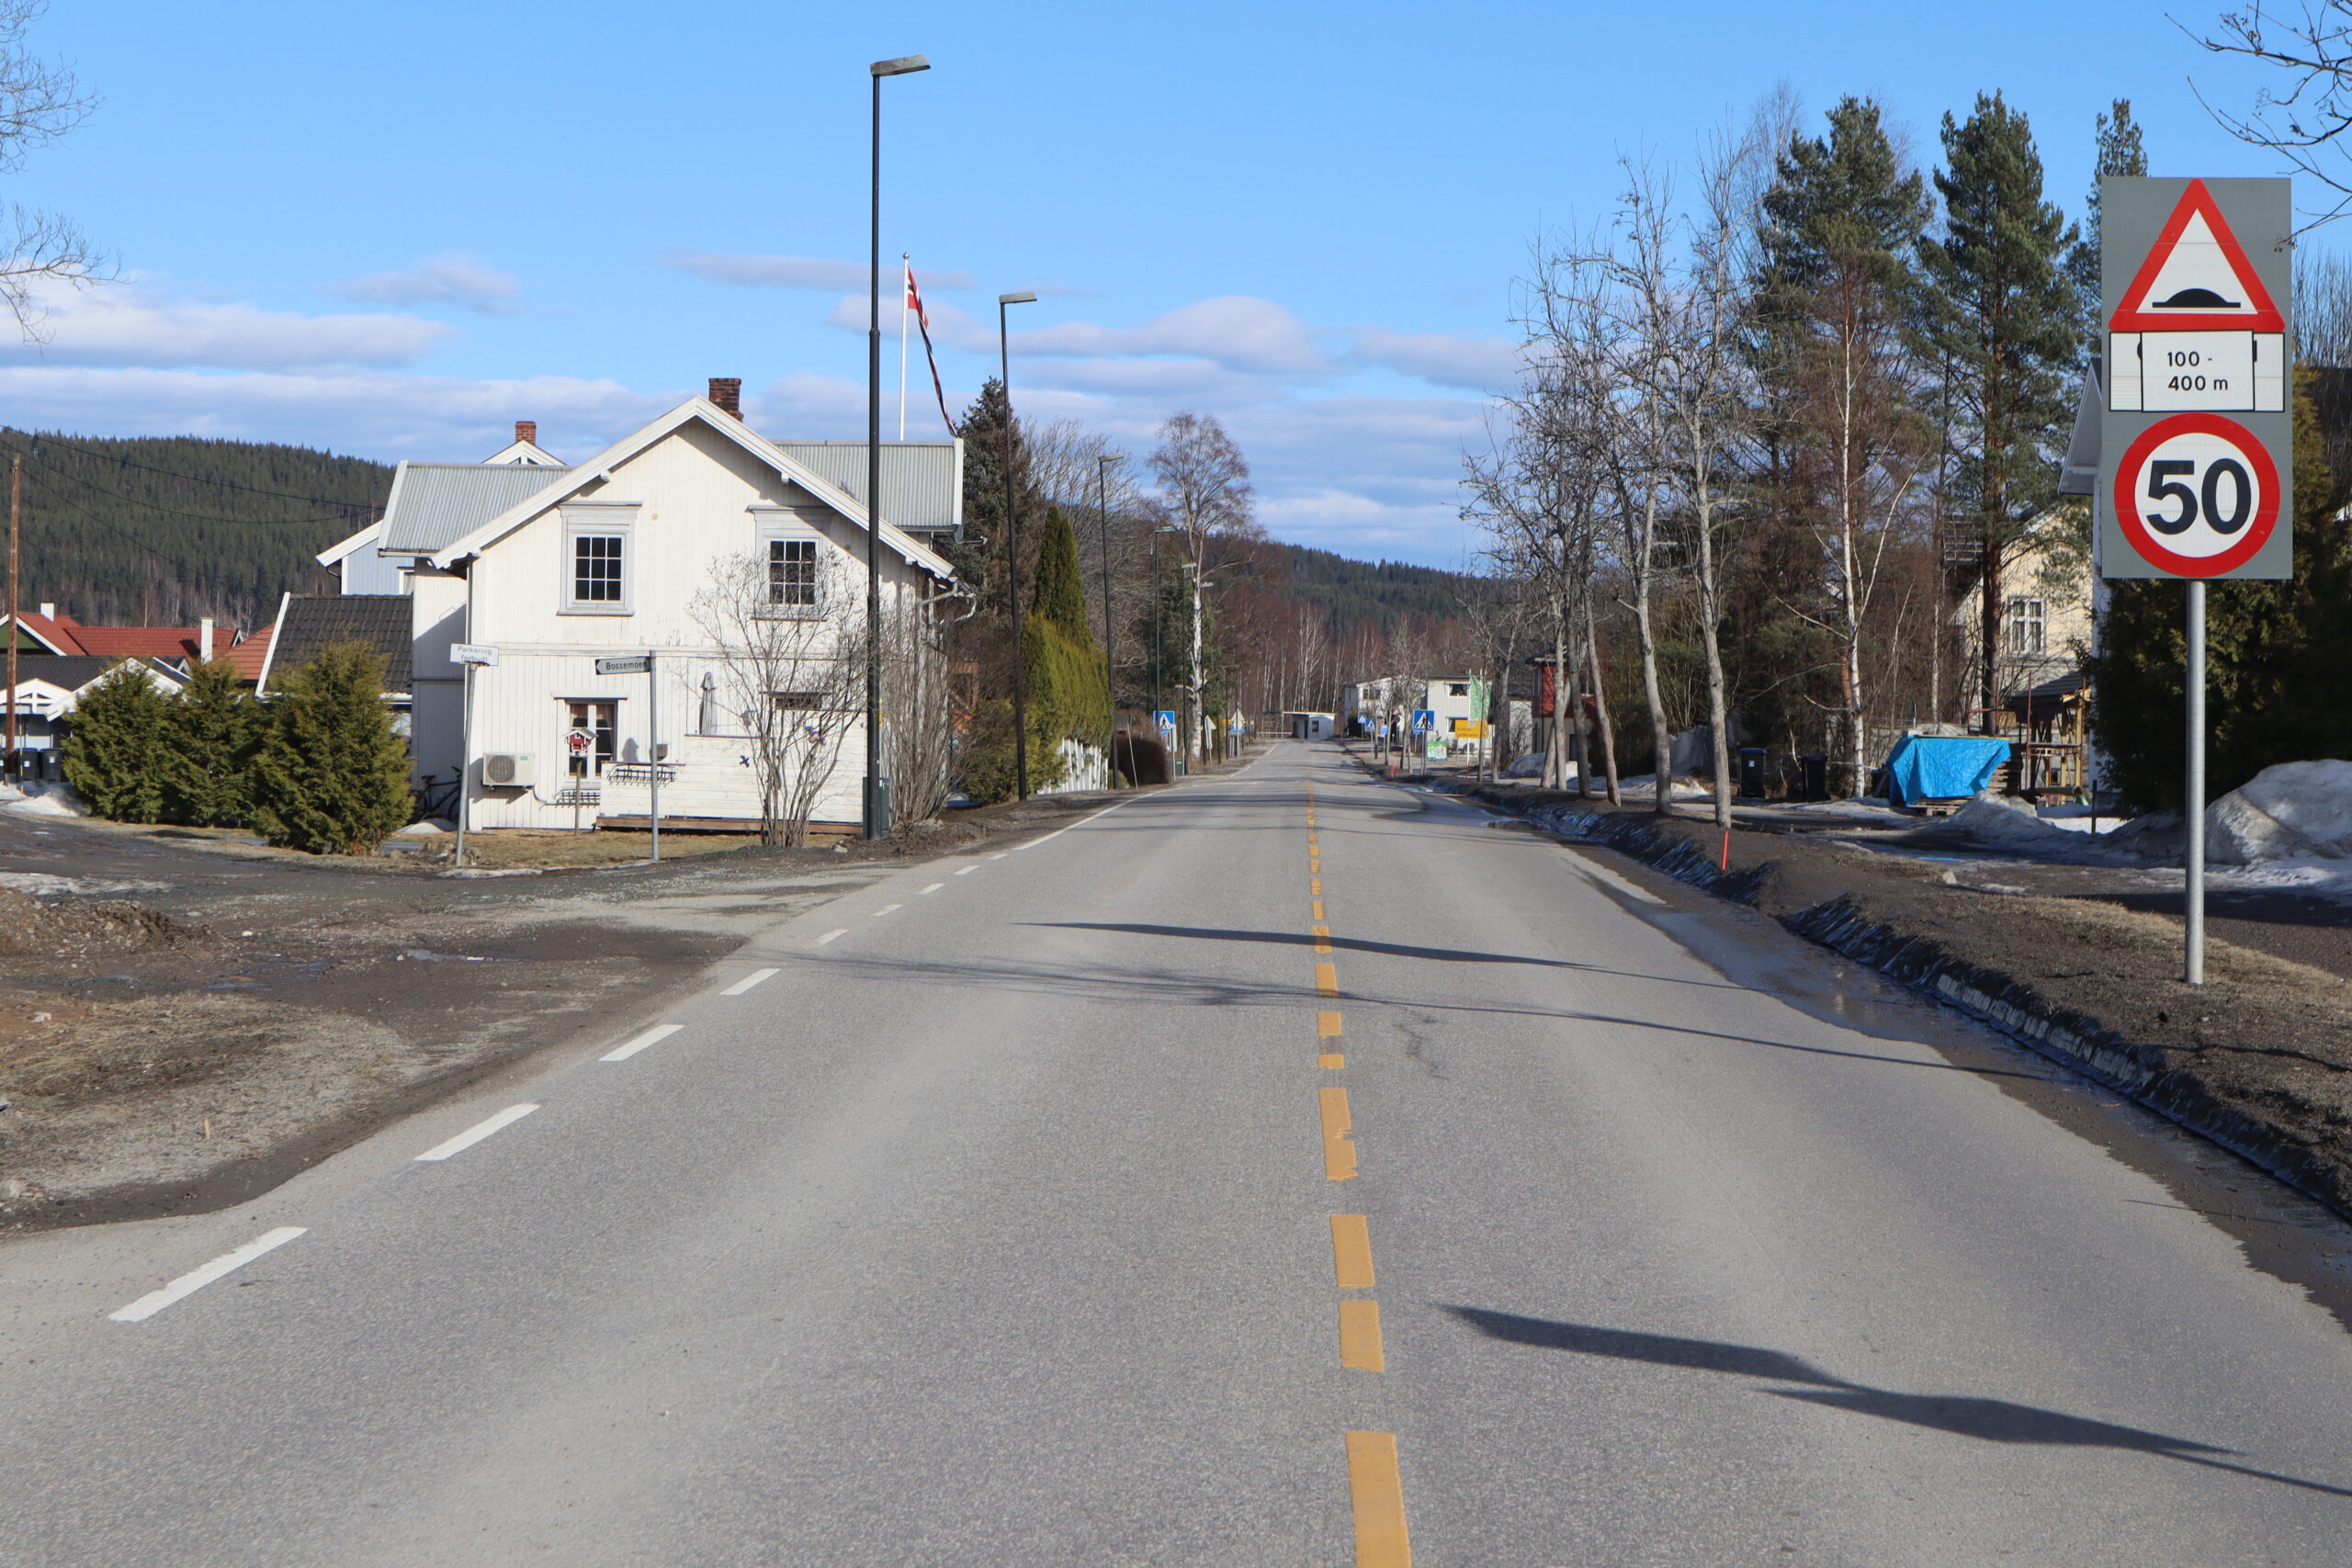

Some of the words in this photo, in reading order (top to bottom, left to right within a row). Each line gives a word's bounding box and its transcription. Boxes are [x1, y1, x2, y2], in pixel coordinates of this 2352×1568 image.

[2167, 351, 2200, 367] 100
[2168, 375, 2206, 391] 400
[2213, 378, 2229, 390] m
[2146, 457, 2252, 536] 50
[458, 646, 492, 656] Parkering
[461, 654, 488, 662] forbudt
